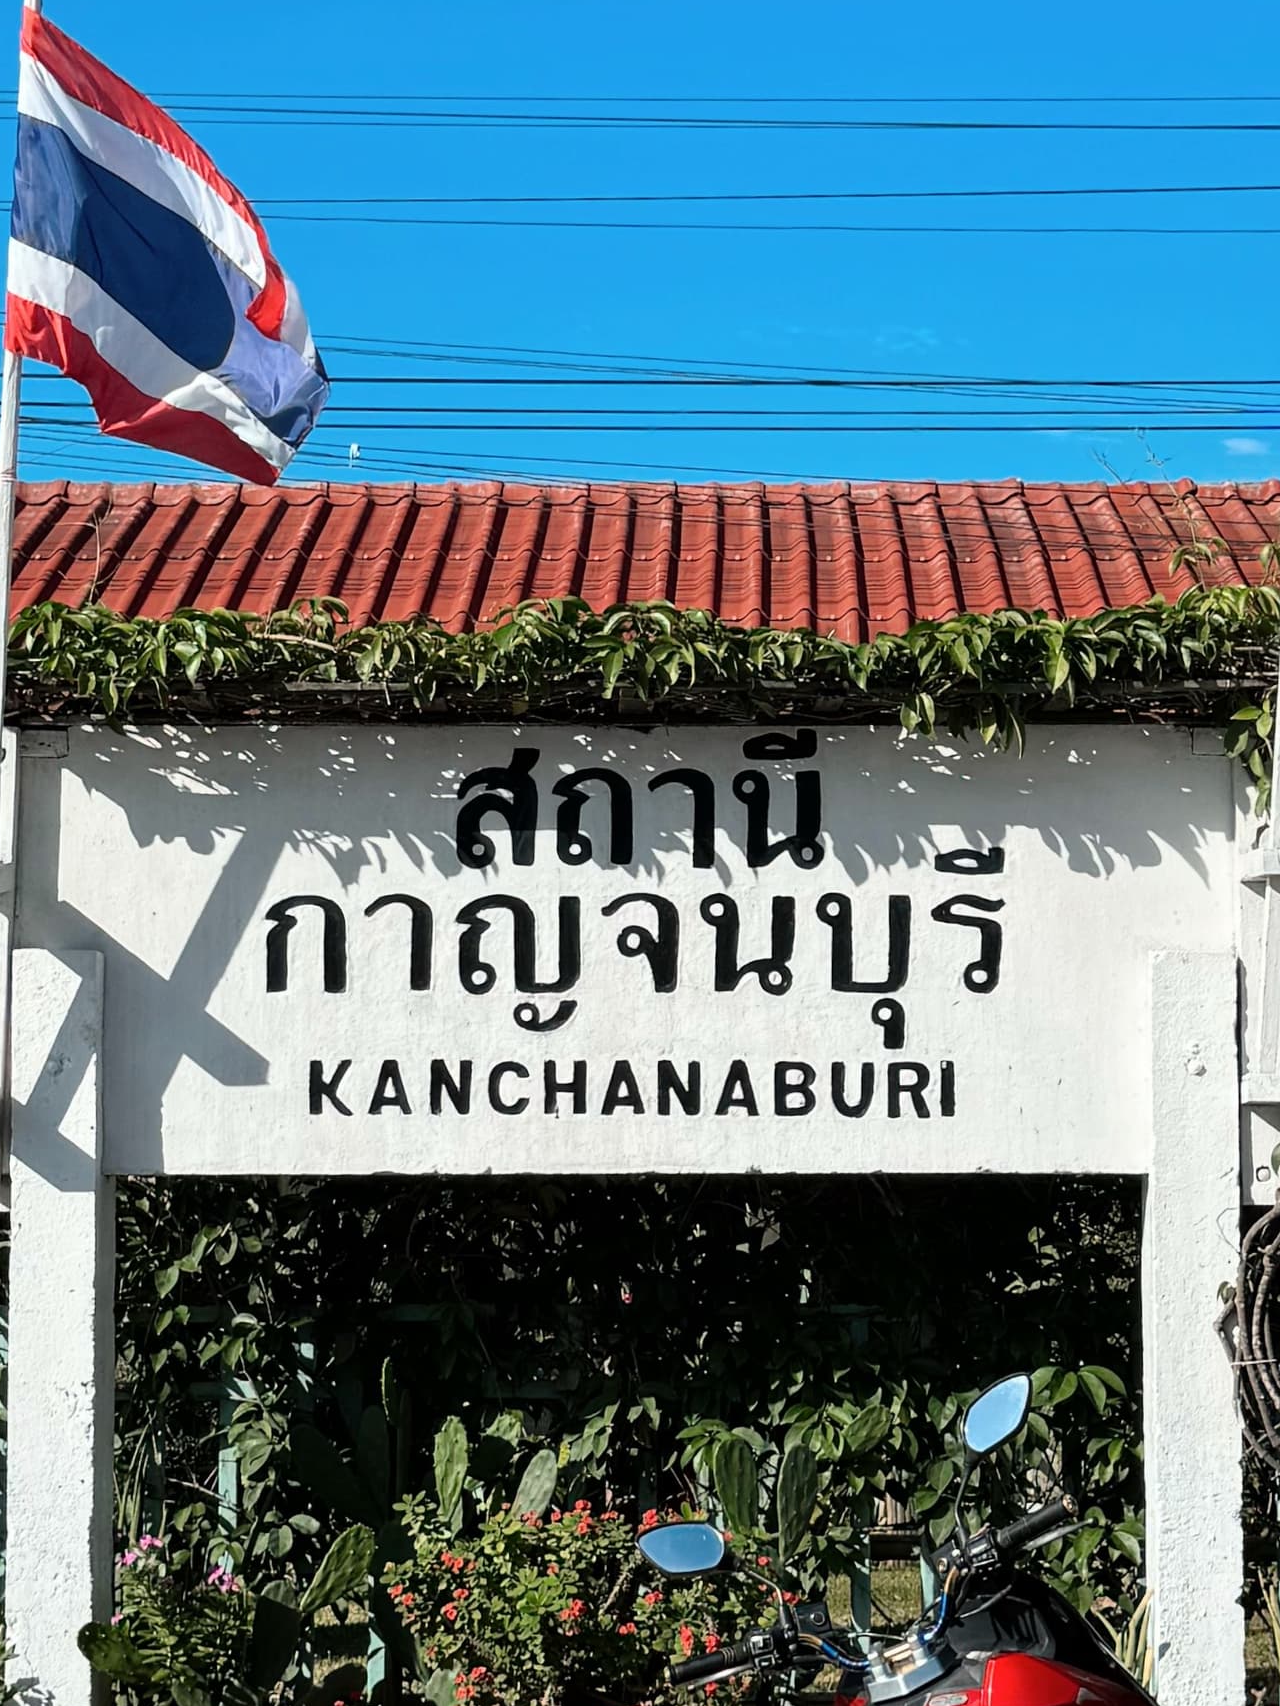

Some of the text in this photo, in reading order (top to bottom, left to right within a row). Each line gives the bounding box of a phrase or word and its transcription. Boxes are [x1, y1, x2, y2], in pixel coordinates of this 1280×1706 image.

[456, 728, 824, 870] สถานี
[266, 846, 1005, 1050] กาญจนบุรี
[308, 1059, 956, 1118] KANCHANABURI
